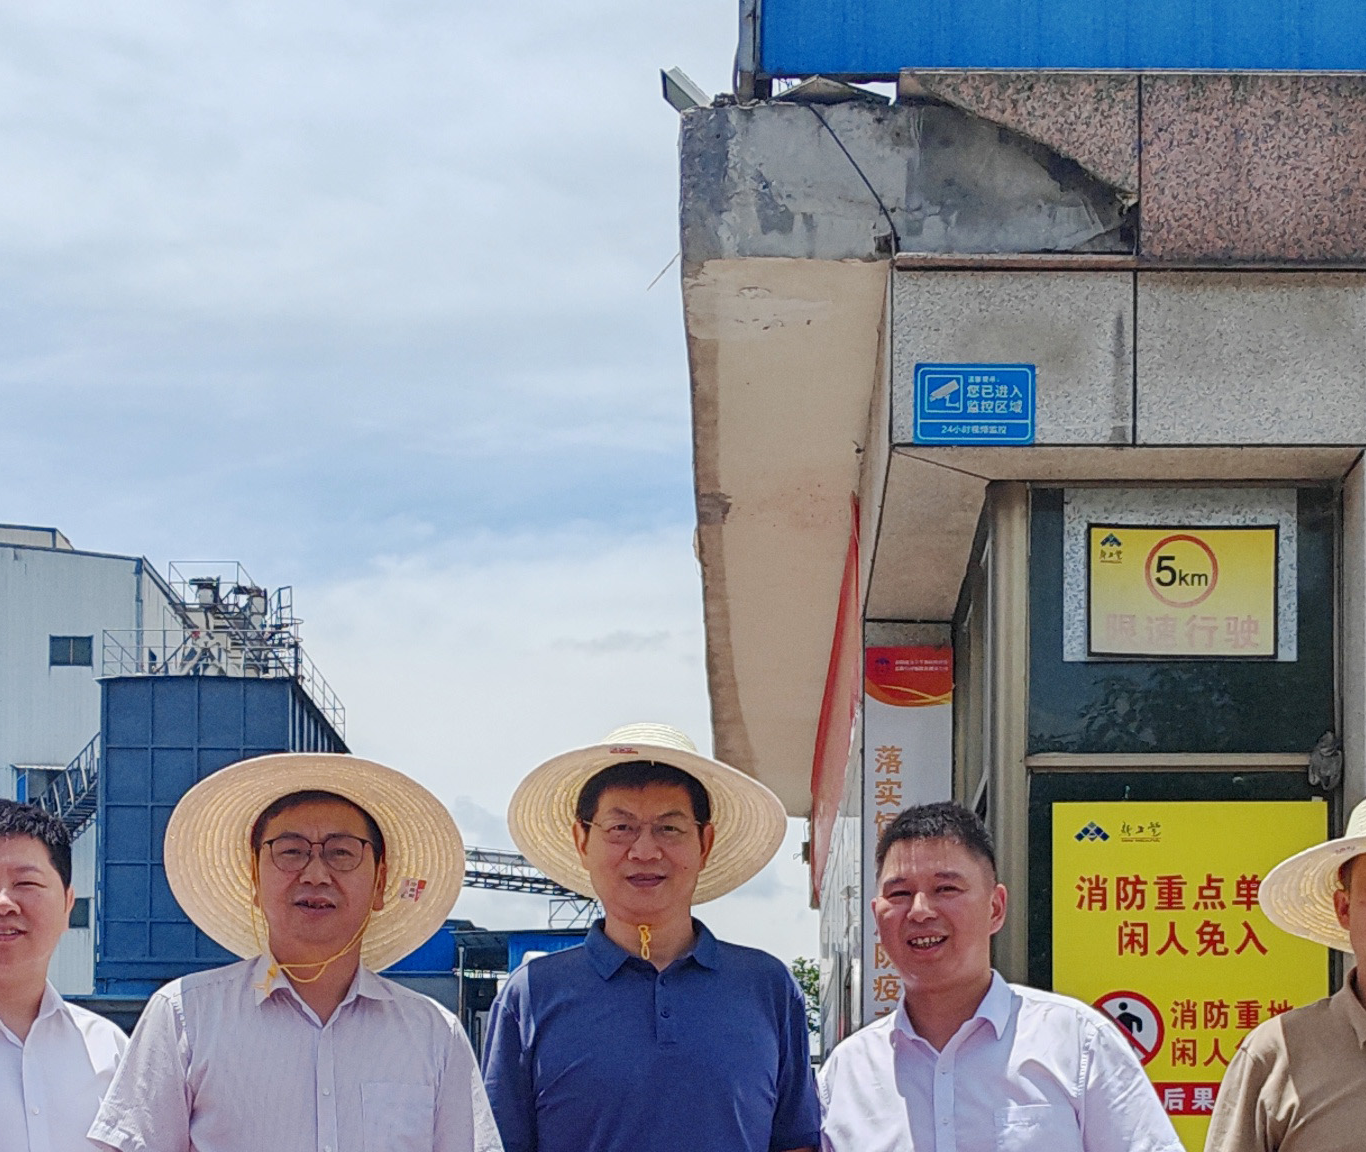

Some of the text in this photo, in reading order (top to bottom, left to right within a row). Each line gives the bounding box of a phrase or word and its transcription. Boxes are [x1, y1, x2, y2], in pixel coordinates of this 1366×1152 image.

[967, 385, 1023, 398] 您已进入
[967, 400, 1023, 413] 监控区域
[1155, 555, 1208, 587] 5km
[1106, 613, 1260, 650] 限速行驶
[1074, 873, 1261, 913] 消防重点单
[1116, 920, 1270, 957] 闲人免入
[1171, 1037, 1246, 1068] 闲人
[1163, 1087, 1215, 1112] 后果
